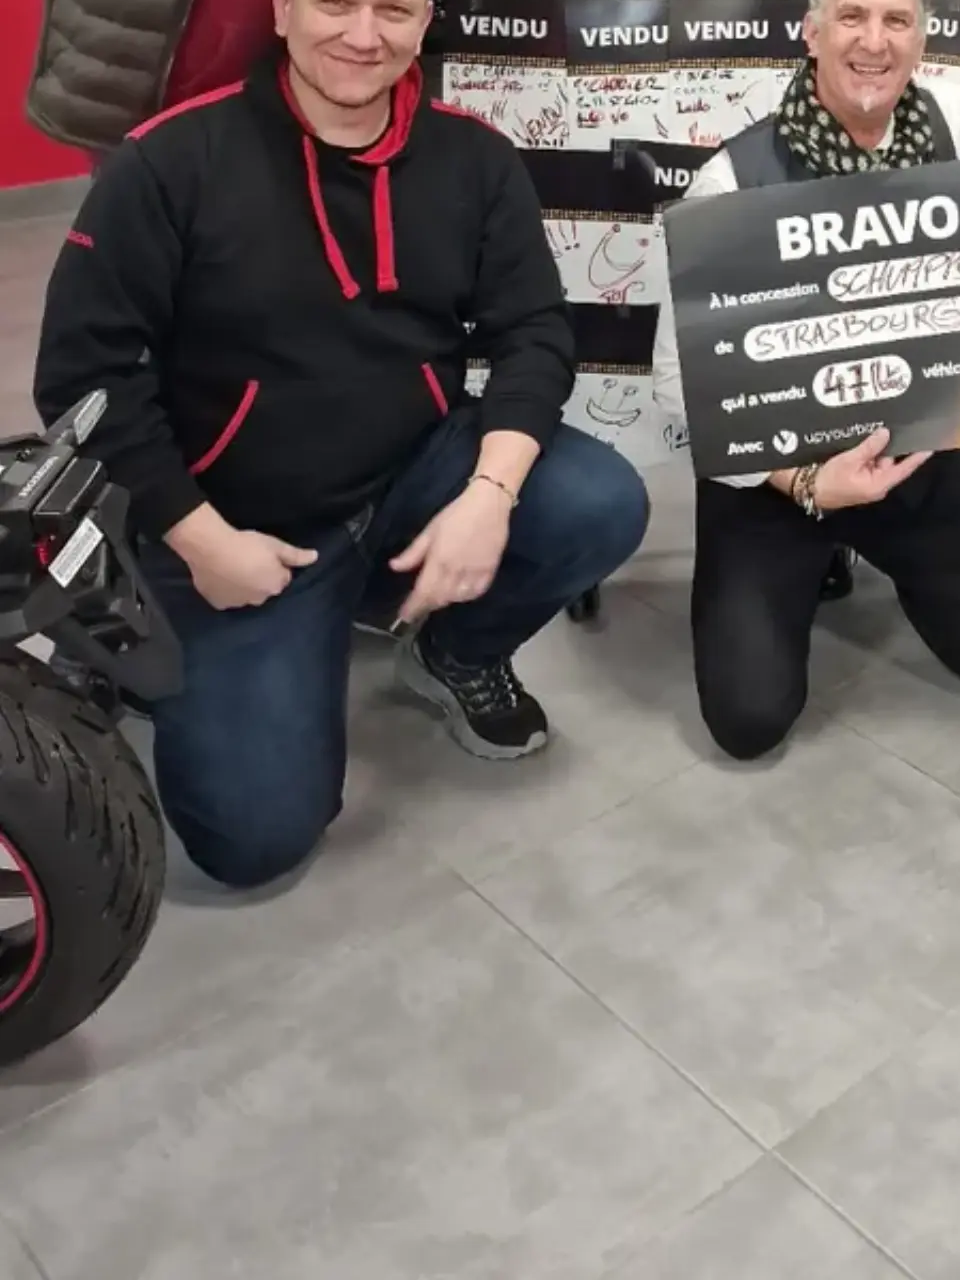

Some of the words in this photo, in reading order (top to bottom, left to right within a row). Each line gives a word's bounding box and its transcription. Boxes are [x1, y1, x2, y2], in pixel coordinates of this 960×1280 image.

[460, 15, 547, 39] VENDU
[580, 24, 669, 47] VENDU
[684, 20, 769, 41] VENDU
[776, 195, 960, 261] BRAVO
[722, 293, 738, 308] la
[739, 281, 820, 305] concession
[713, 339, 735, 356] de
[720, 393, 746, 414] qui
[748, 394, 760, 407] a
[760, 385, 808, 405] vendu
[726, 439, 765, 456] Avec
